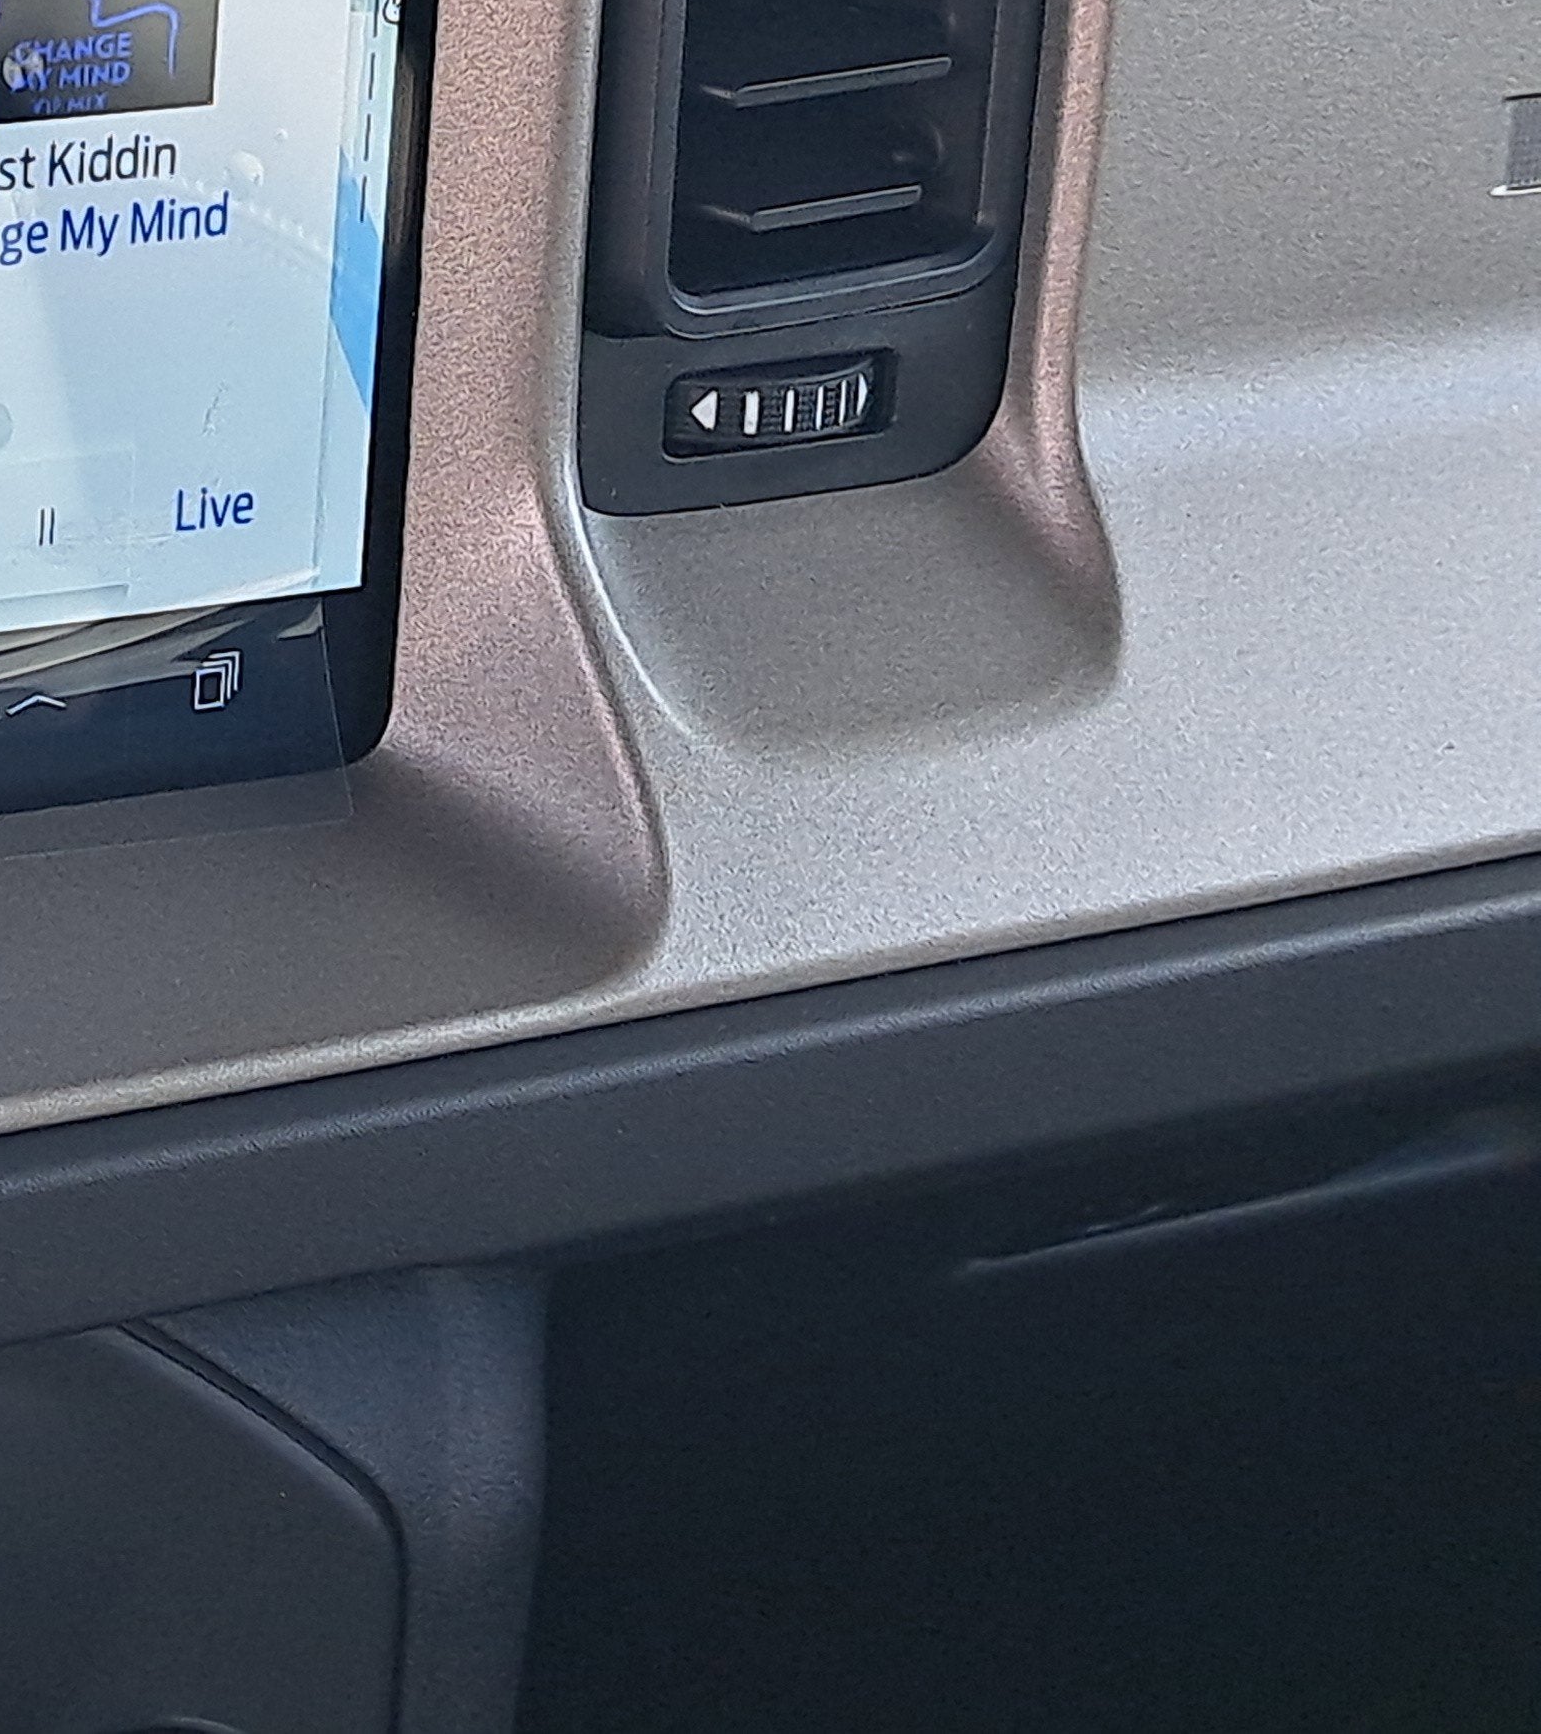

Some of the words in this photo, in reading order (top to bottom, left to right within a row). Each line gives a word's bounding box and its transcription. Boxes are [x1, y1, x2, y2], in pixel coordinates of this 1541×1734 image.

[14, 31, 133, 66] CHANGE
[58, 61, 131, 90] MIND
[47, 134, 177, 187] Kiddin
[59, 206, 120, 256] My
[130, 190, 230, 245] Mind
[175, 487, 255, 532] Live
